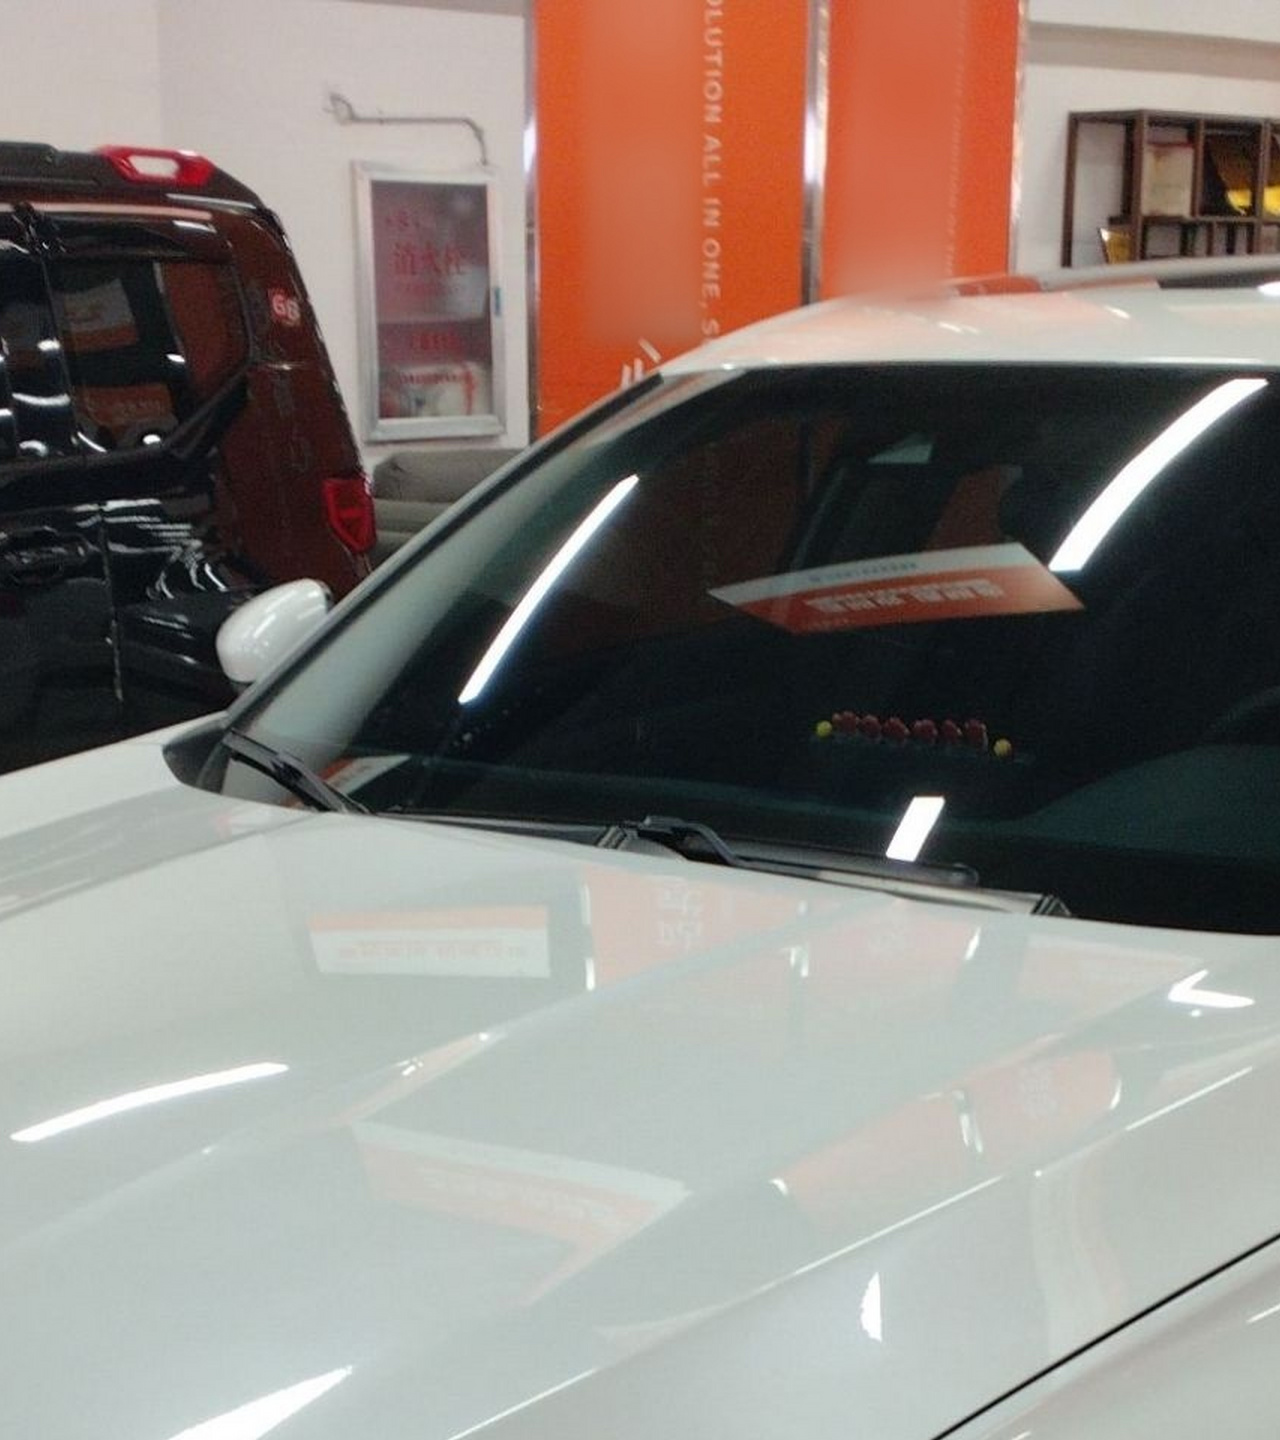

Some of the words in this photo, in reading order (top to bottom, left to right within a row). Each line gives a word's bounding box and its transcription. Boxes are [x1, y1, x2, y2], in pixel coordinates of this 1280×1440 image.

[704, 0, 723, 123] LUTION
[702, 132, 722, 187] ALL
[702, 198, 721, 227] IN
